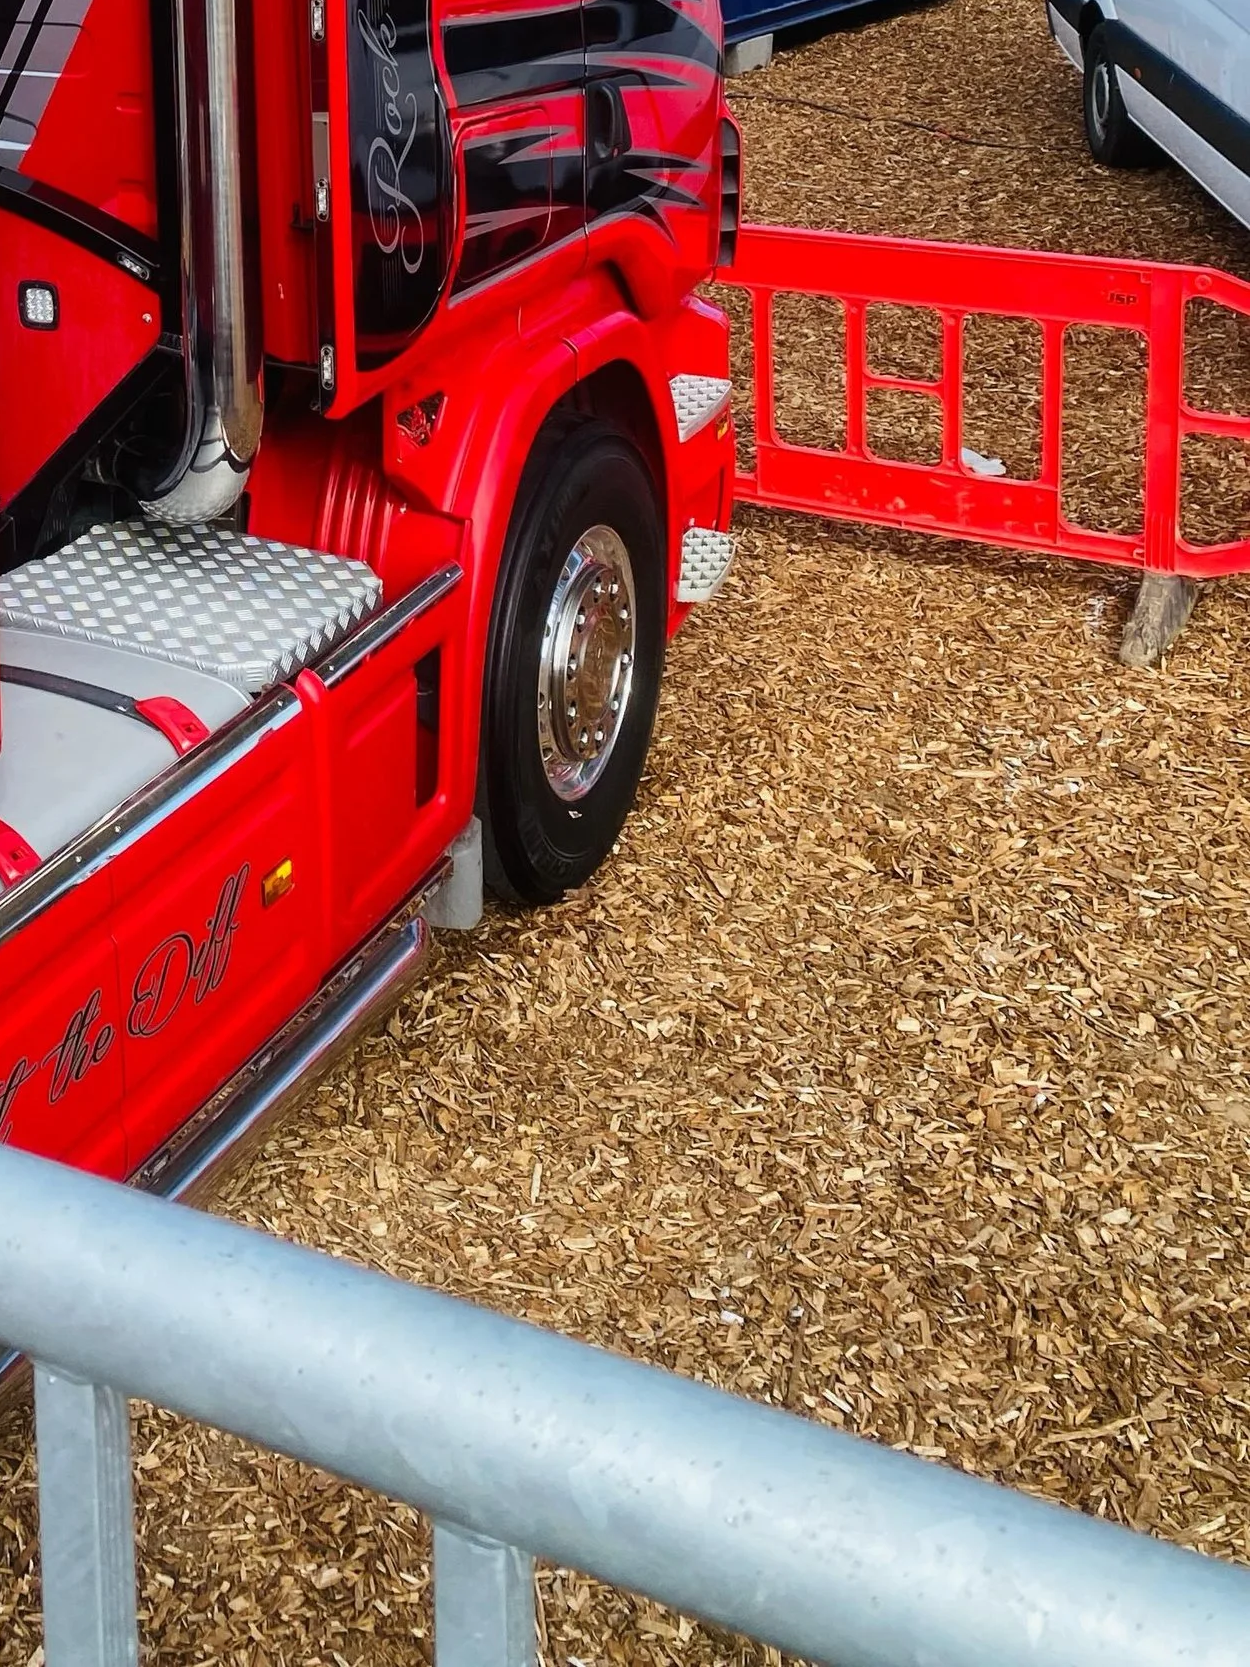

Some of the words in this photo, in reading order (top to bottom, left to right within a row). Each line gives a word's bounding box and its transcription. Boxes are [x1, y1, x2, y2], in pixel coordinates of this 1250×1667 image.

[358, 9, 424, 275] Rock
[41, 988, 116, 1105] the
[127, 862, 250, 1037] Diff
